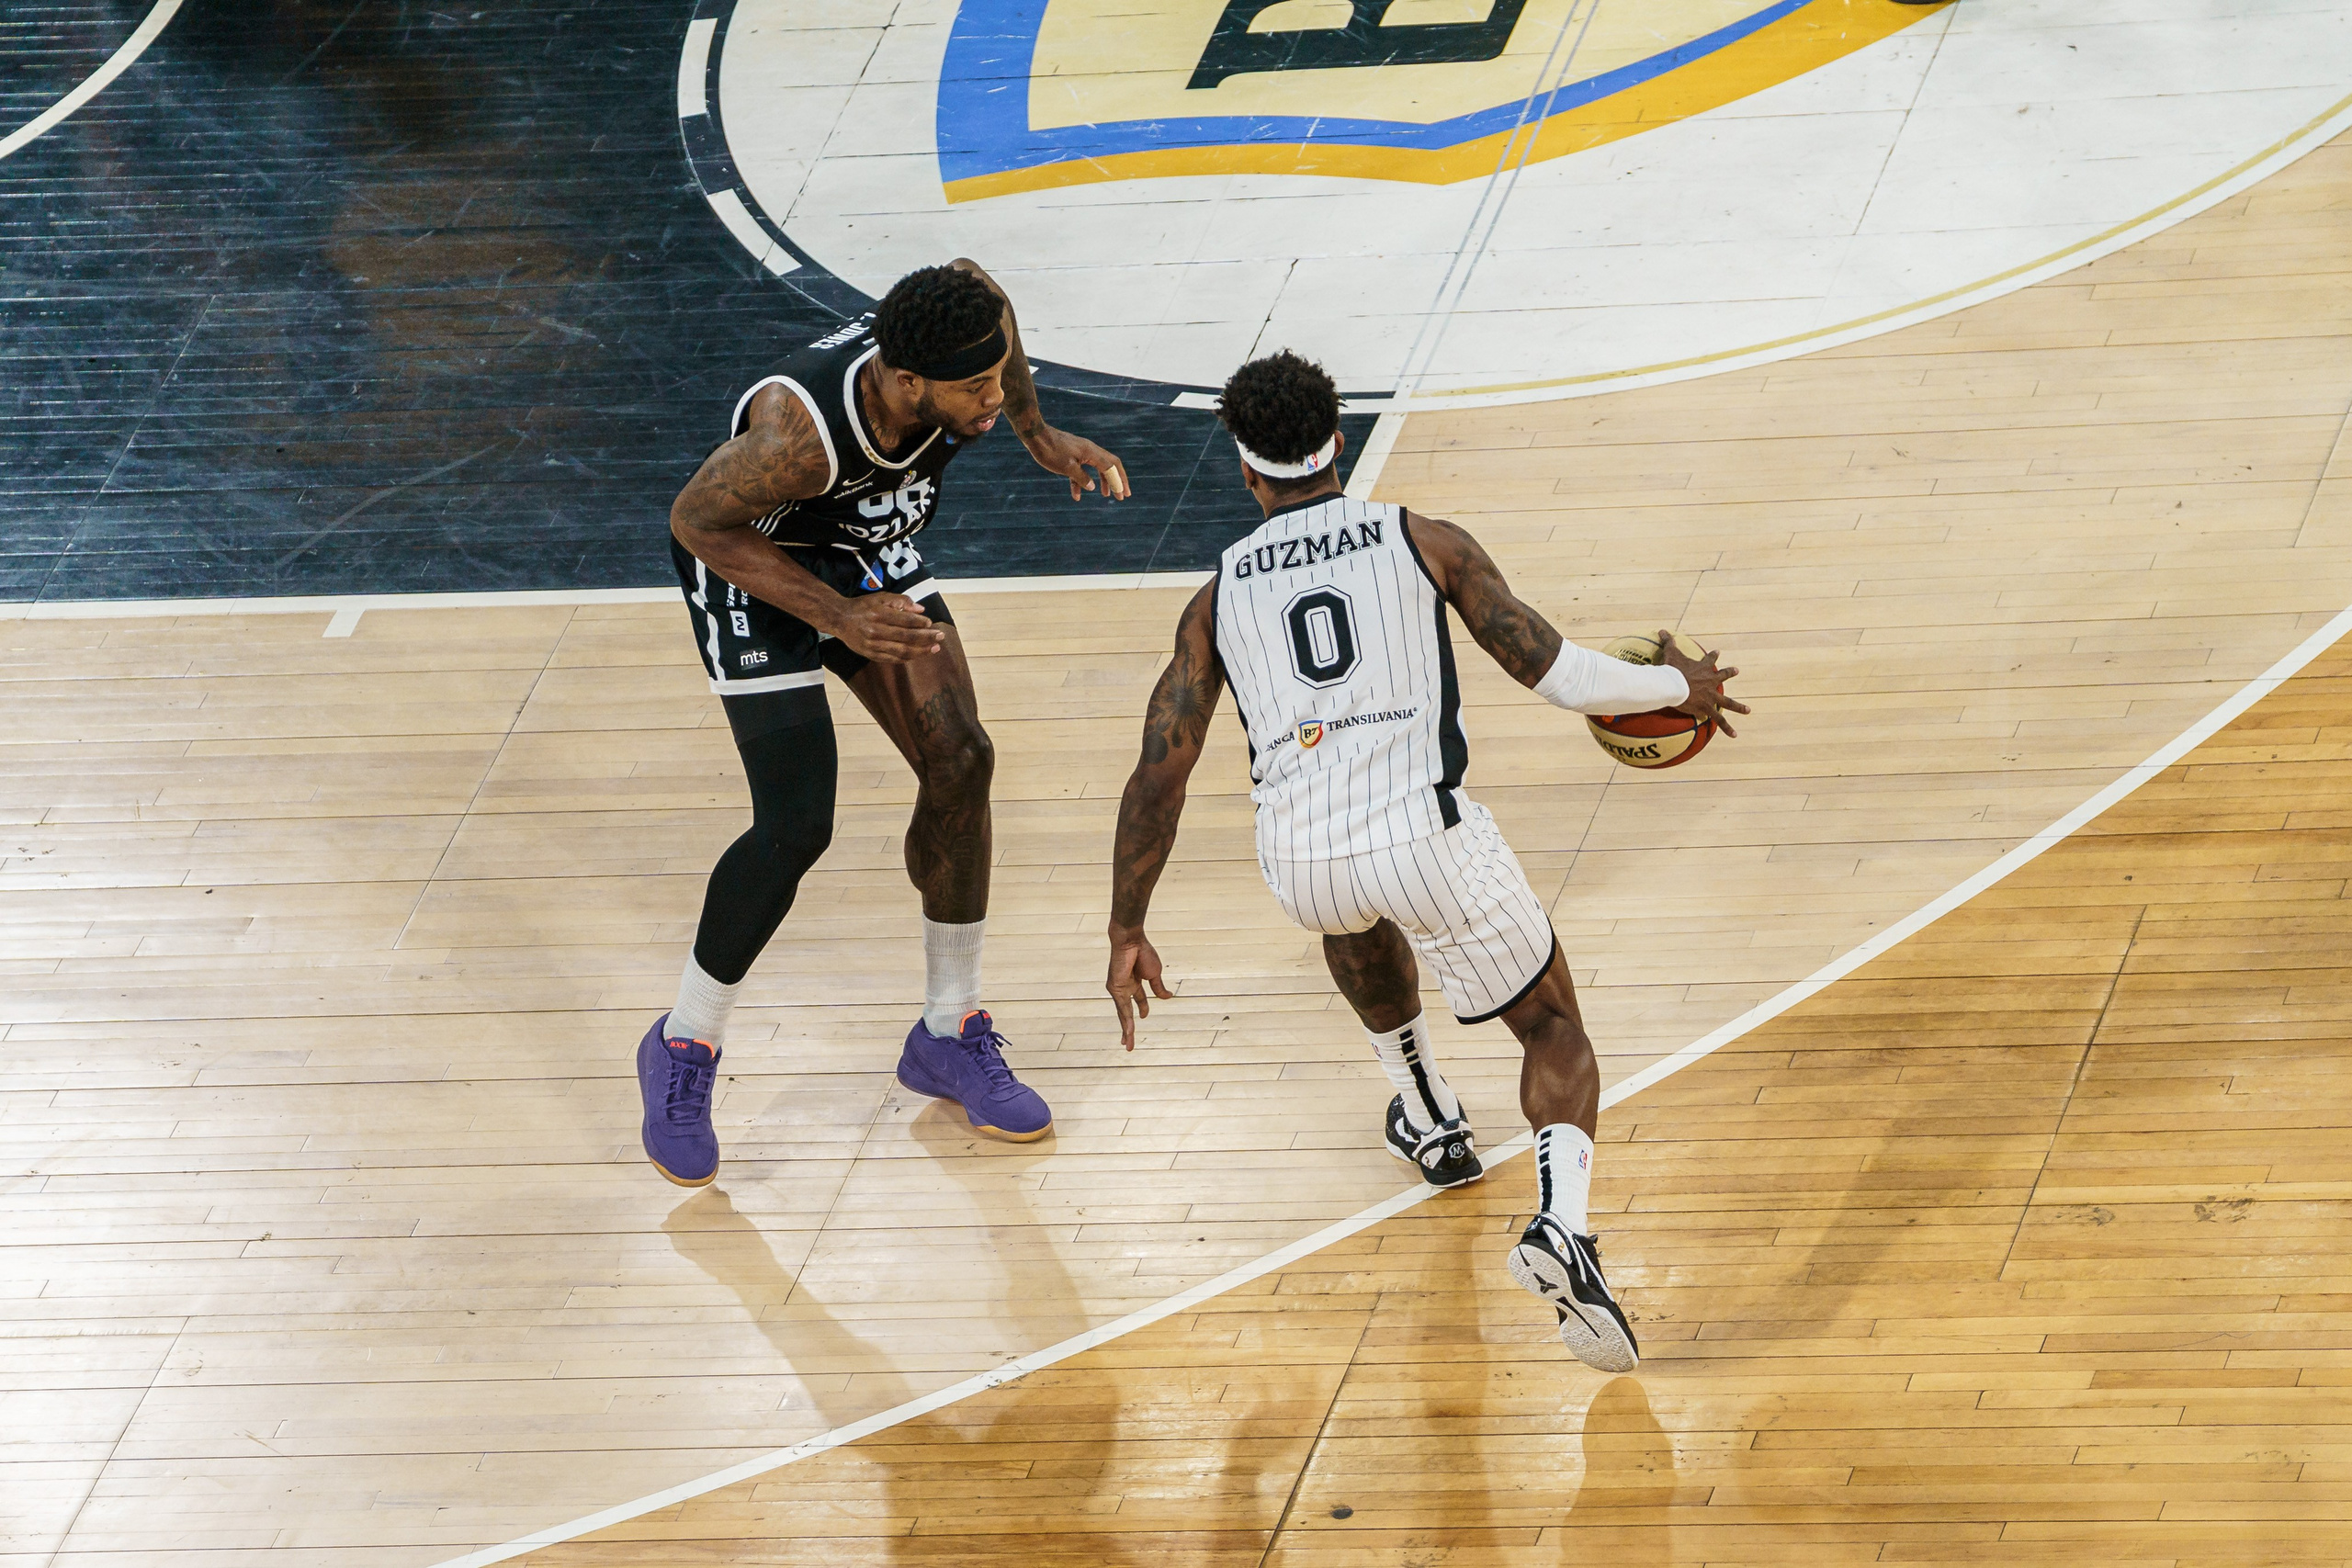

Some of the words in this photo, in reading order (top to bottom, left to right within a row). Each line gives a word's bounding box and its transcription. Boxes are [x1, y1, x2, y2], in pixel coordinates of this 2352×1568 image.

[1235, 519, 1385, 581] GUZMAN
[1281, 584, 1363, 690] 0
[741, 650, 768, 666] mts
[1265, 731, 1295, 752] ANCA
